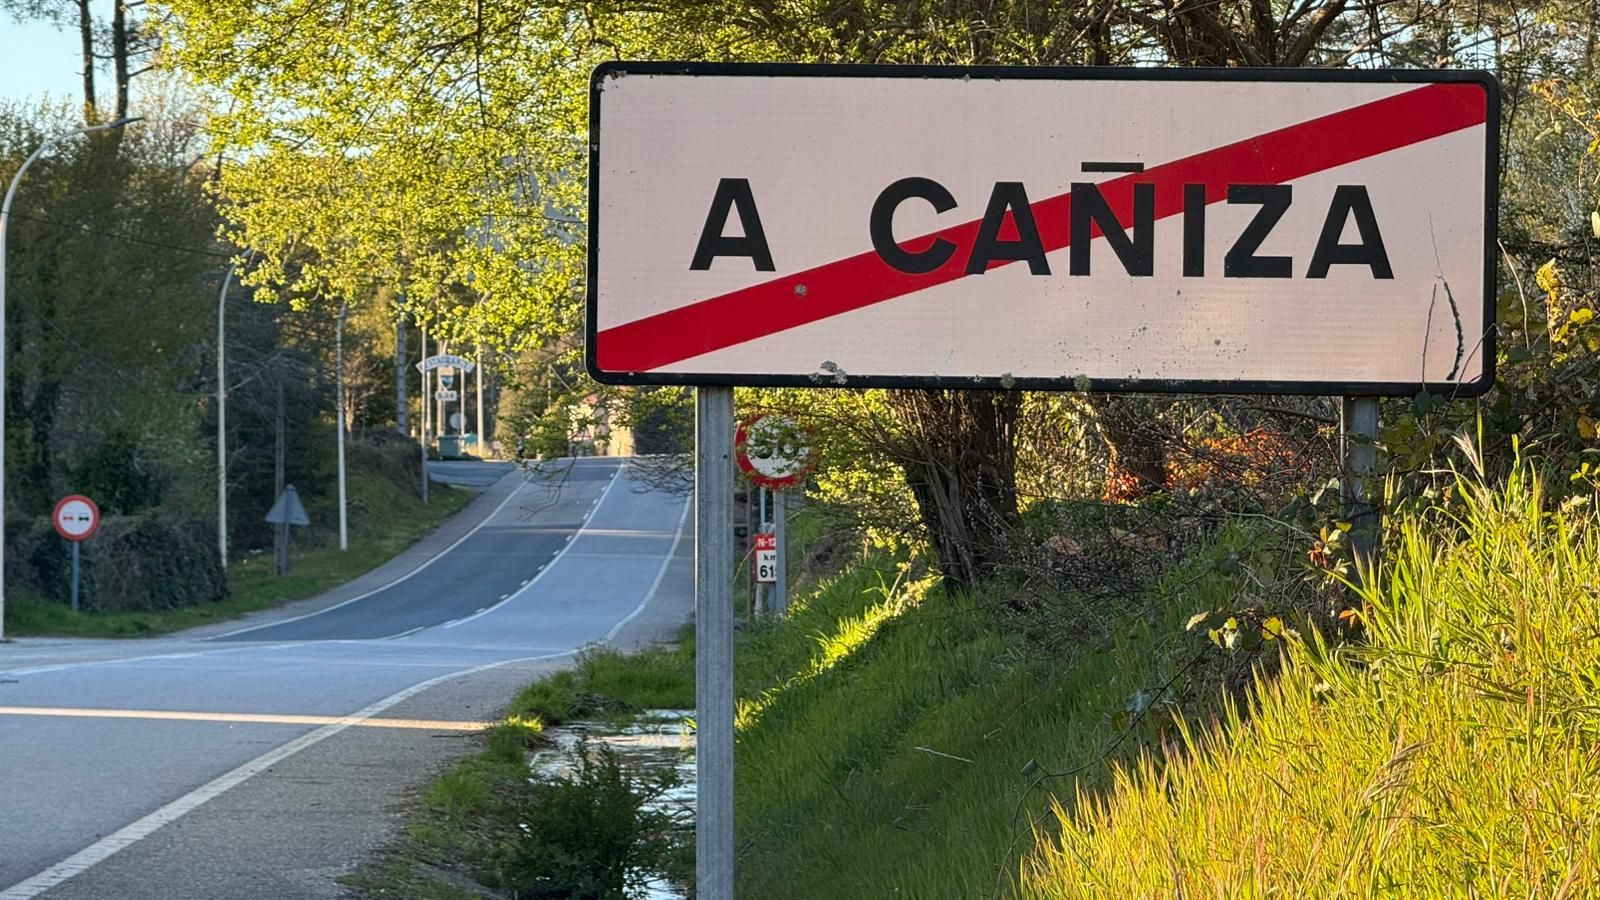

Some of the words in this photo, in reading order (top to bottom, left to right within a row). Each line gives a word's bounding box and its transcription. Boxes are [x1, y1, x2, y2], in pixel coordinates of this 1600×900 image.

[690, 178, 776, 271] A
[869, 161, 1394, 280] CAÑIZA
[760, 565, 777, 578] 61
